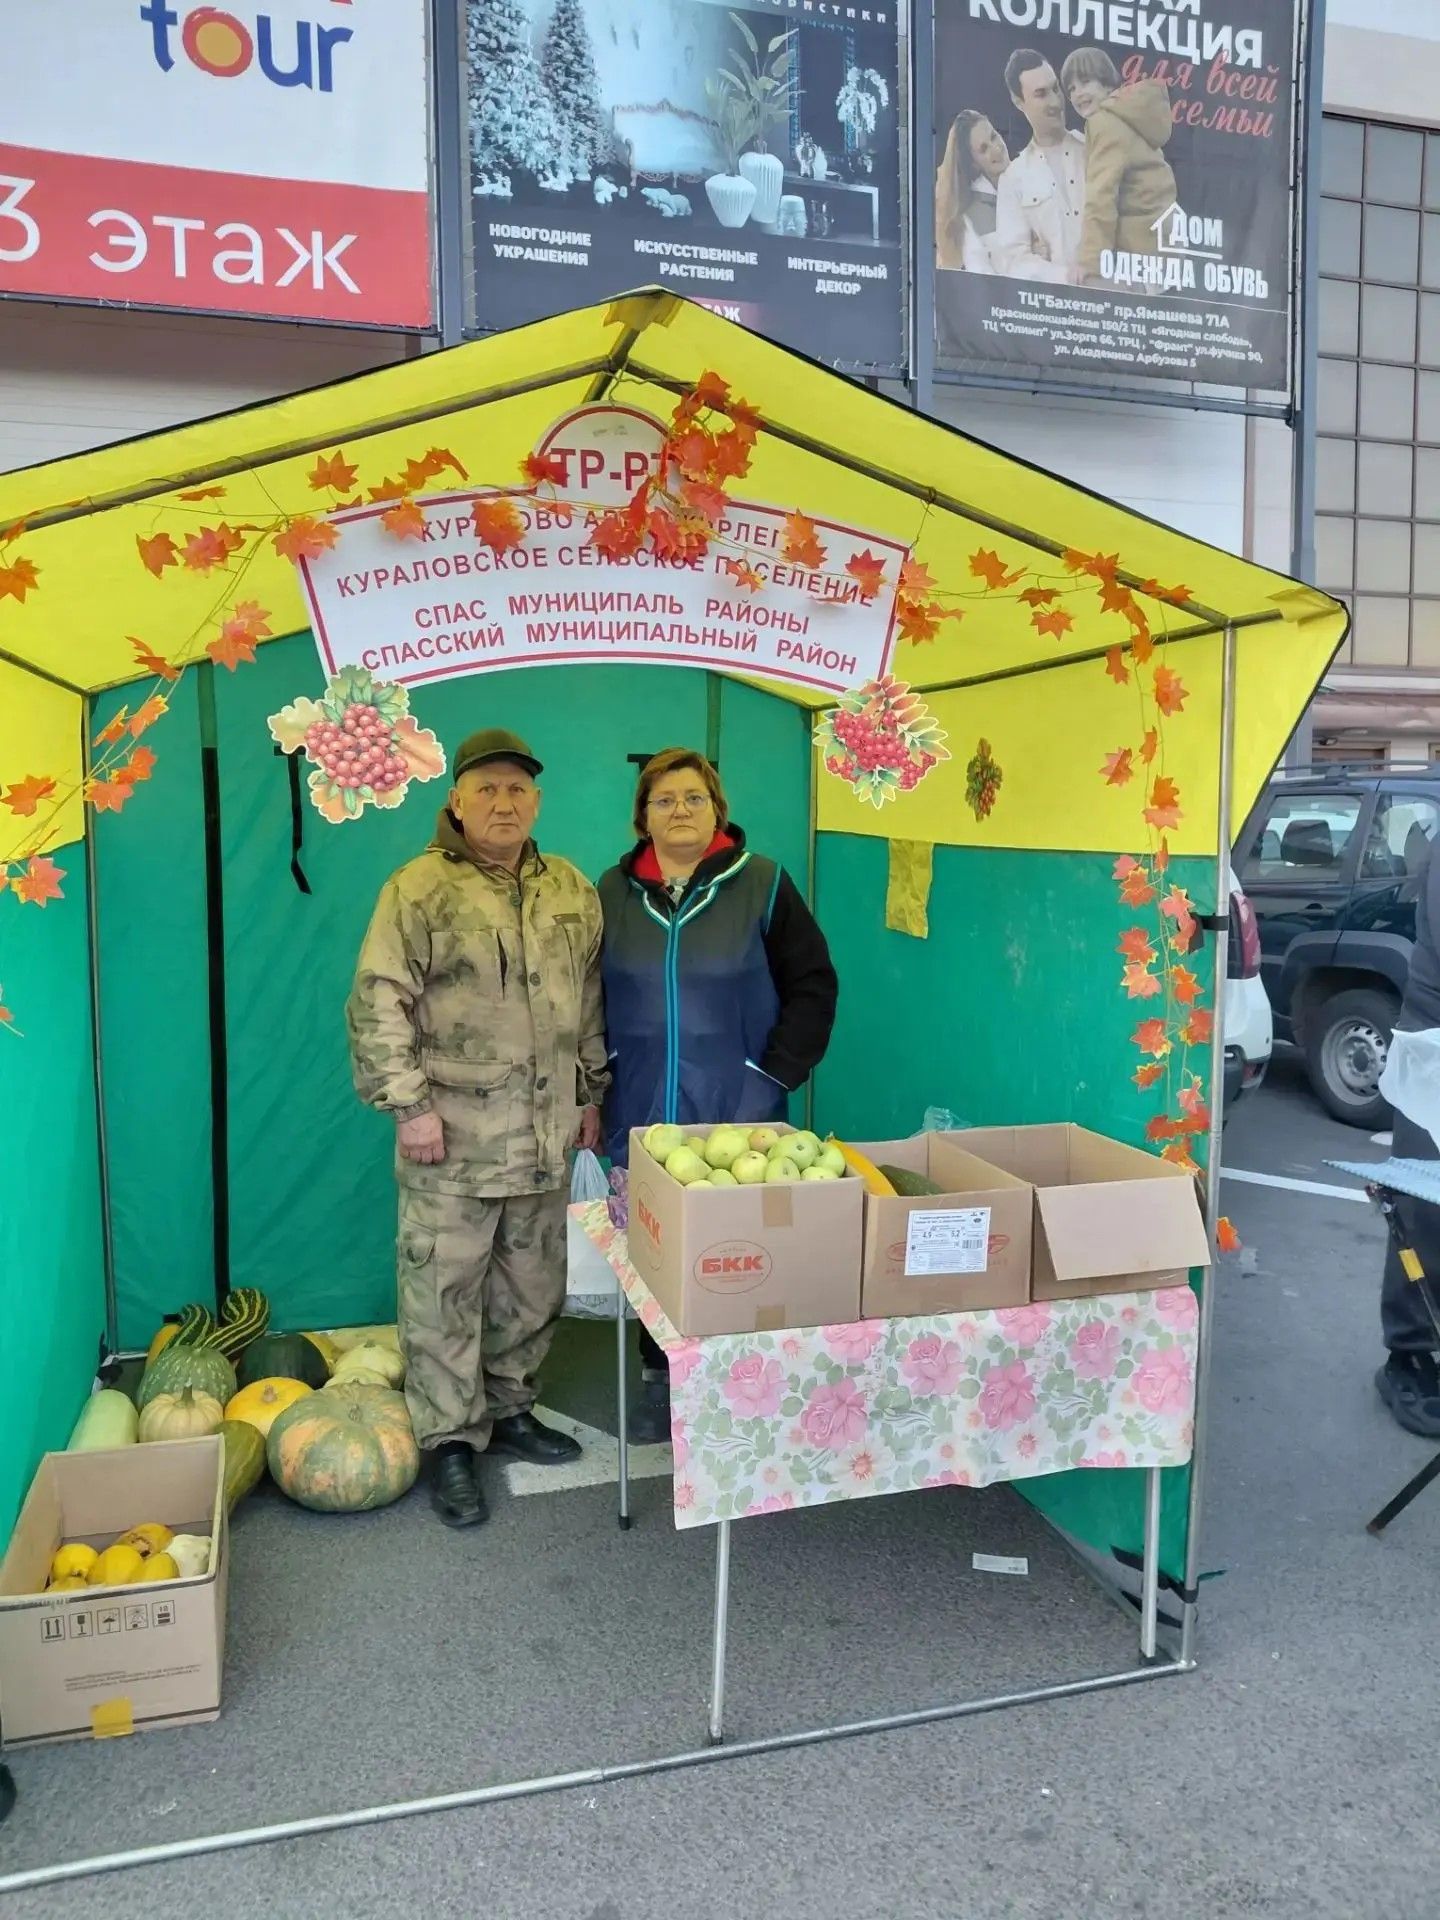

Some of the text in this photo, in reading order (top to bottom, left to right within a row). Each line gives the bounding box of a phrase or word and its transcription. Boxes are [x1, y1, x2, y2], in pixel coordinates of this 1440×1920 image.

[140, 0, 354, 93] tour
[969, 0, 1263, 69] КОЛЛЕКЦИЯ
[1207, 49, 1281, 104] всей
[1170, 98, 1274, 138] семьи
[0, 174, 362, 295] 3 этаж
[489, 223, 592, 247] НОВОГОДНИЕ
[1169, 213, 1223, 248] ДОМ
[493, 244, 589, 267] УКРАШЕНИЯ
[633, 239, 758, 265] ИСКУССТВЕННЫЕ
[659, 261, 735, 283] РАСТЕНИЯ
[787, 256, 888, 280] ИНТЕРЬЕРНЫЙ
[1100, 249, 1269, 299] ОДЕЖДА ОБУВЬ
[815, 278, 862, 296] ДЕКОР
[982, 319, 999, 333] ТЦ
[1130, 322, 1147, 336] ТЦ
[1072, 344, 1135, 362] Академика
[1135, 352, 1189, 367] Арбузова
[337, 547, 549, 598] КУРАЛОВСКОЕ
[414, 592, 810, 635] СПАС МУНИЦИПАЛЬ РАЙОНЫ
[361, 620, 857, 675] СПАССКИЙ МУНИЦИПАЛЬНЫЙ РАЙОН
[701, 1254, 764, 1275] БКК
